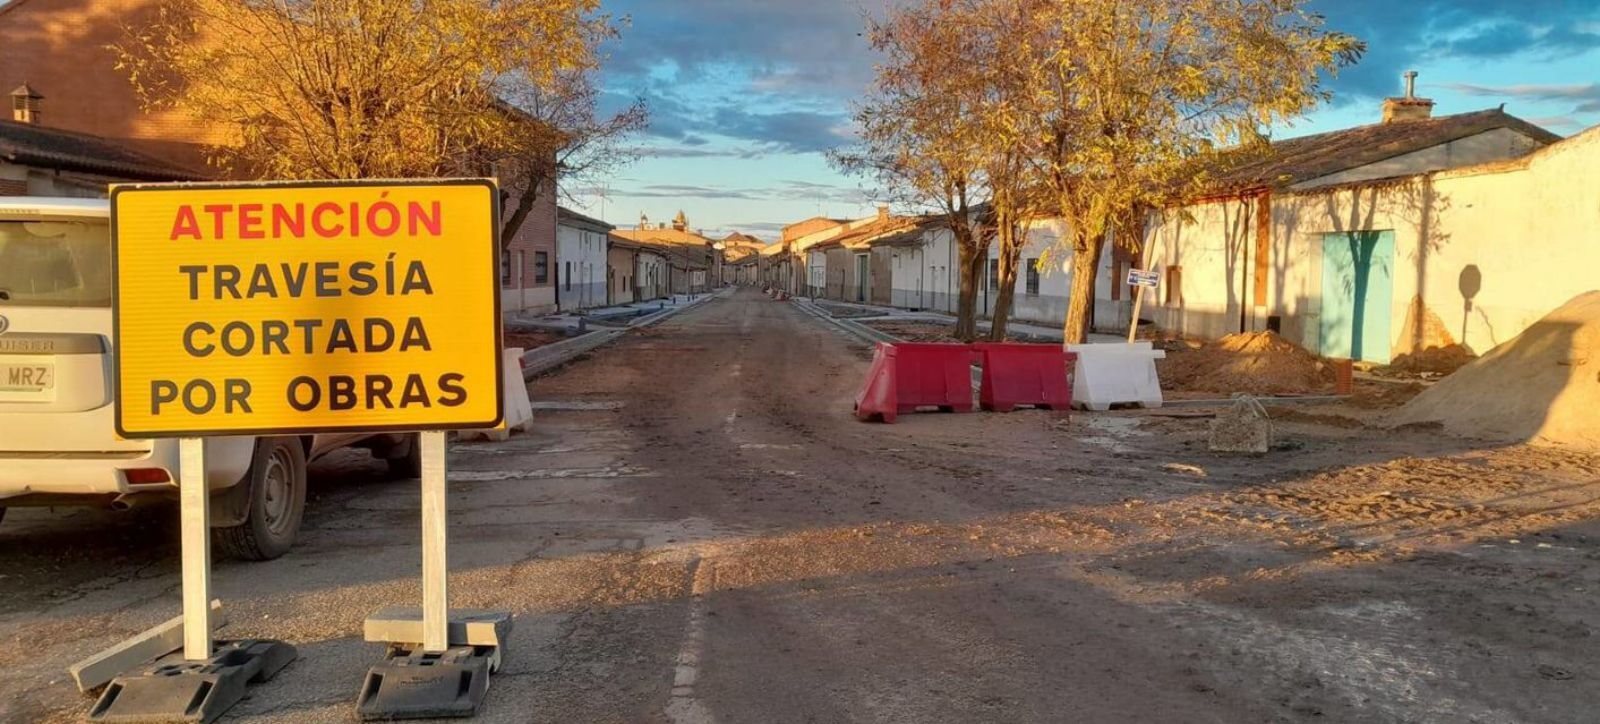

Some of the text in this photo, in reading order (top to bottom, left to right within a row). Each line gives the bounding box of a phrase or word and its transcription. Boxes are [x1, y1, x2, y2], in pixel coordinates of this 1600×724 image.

[169, 191, 443, 241] ATENCIÓN
[179, 252, 434, 300] TRAVESÍA
[182, 316, 432, 358] CORTADA
[8, 366, 47, 386] MRZ
[150, 372, 468, 416] POR OBRAS
